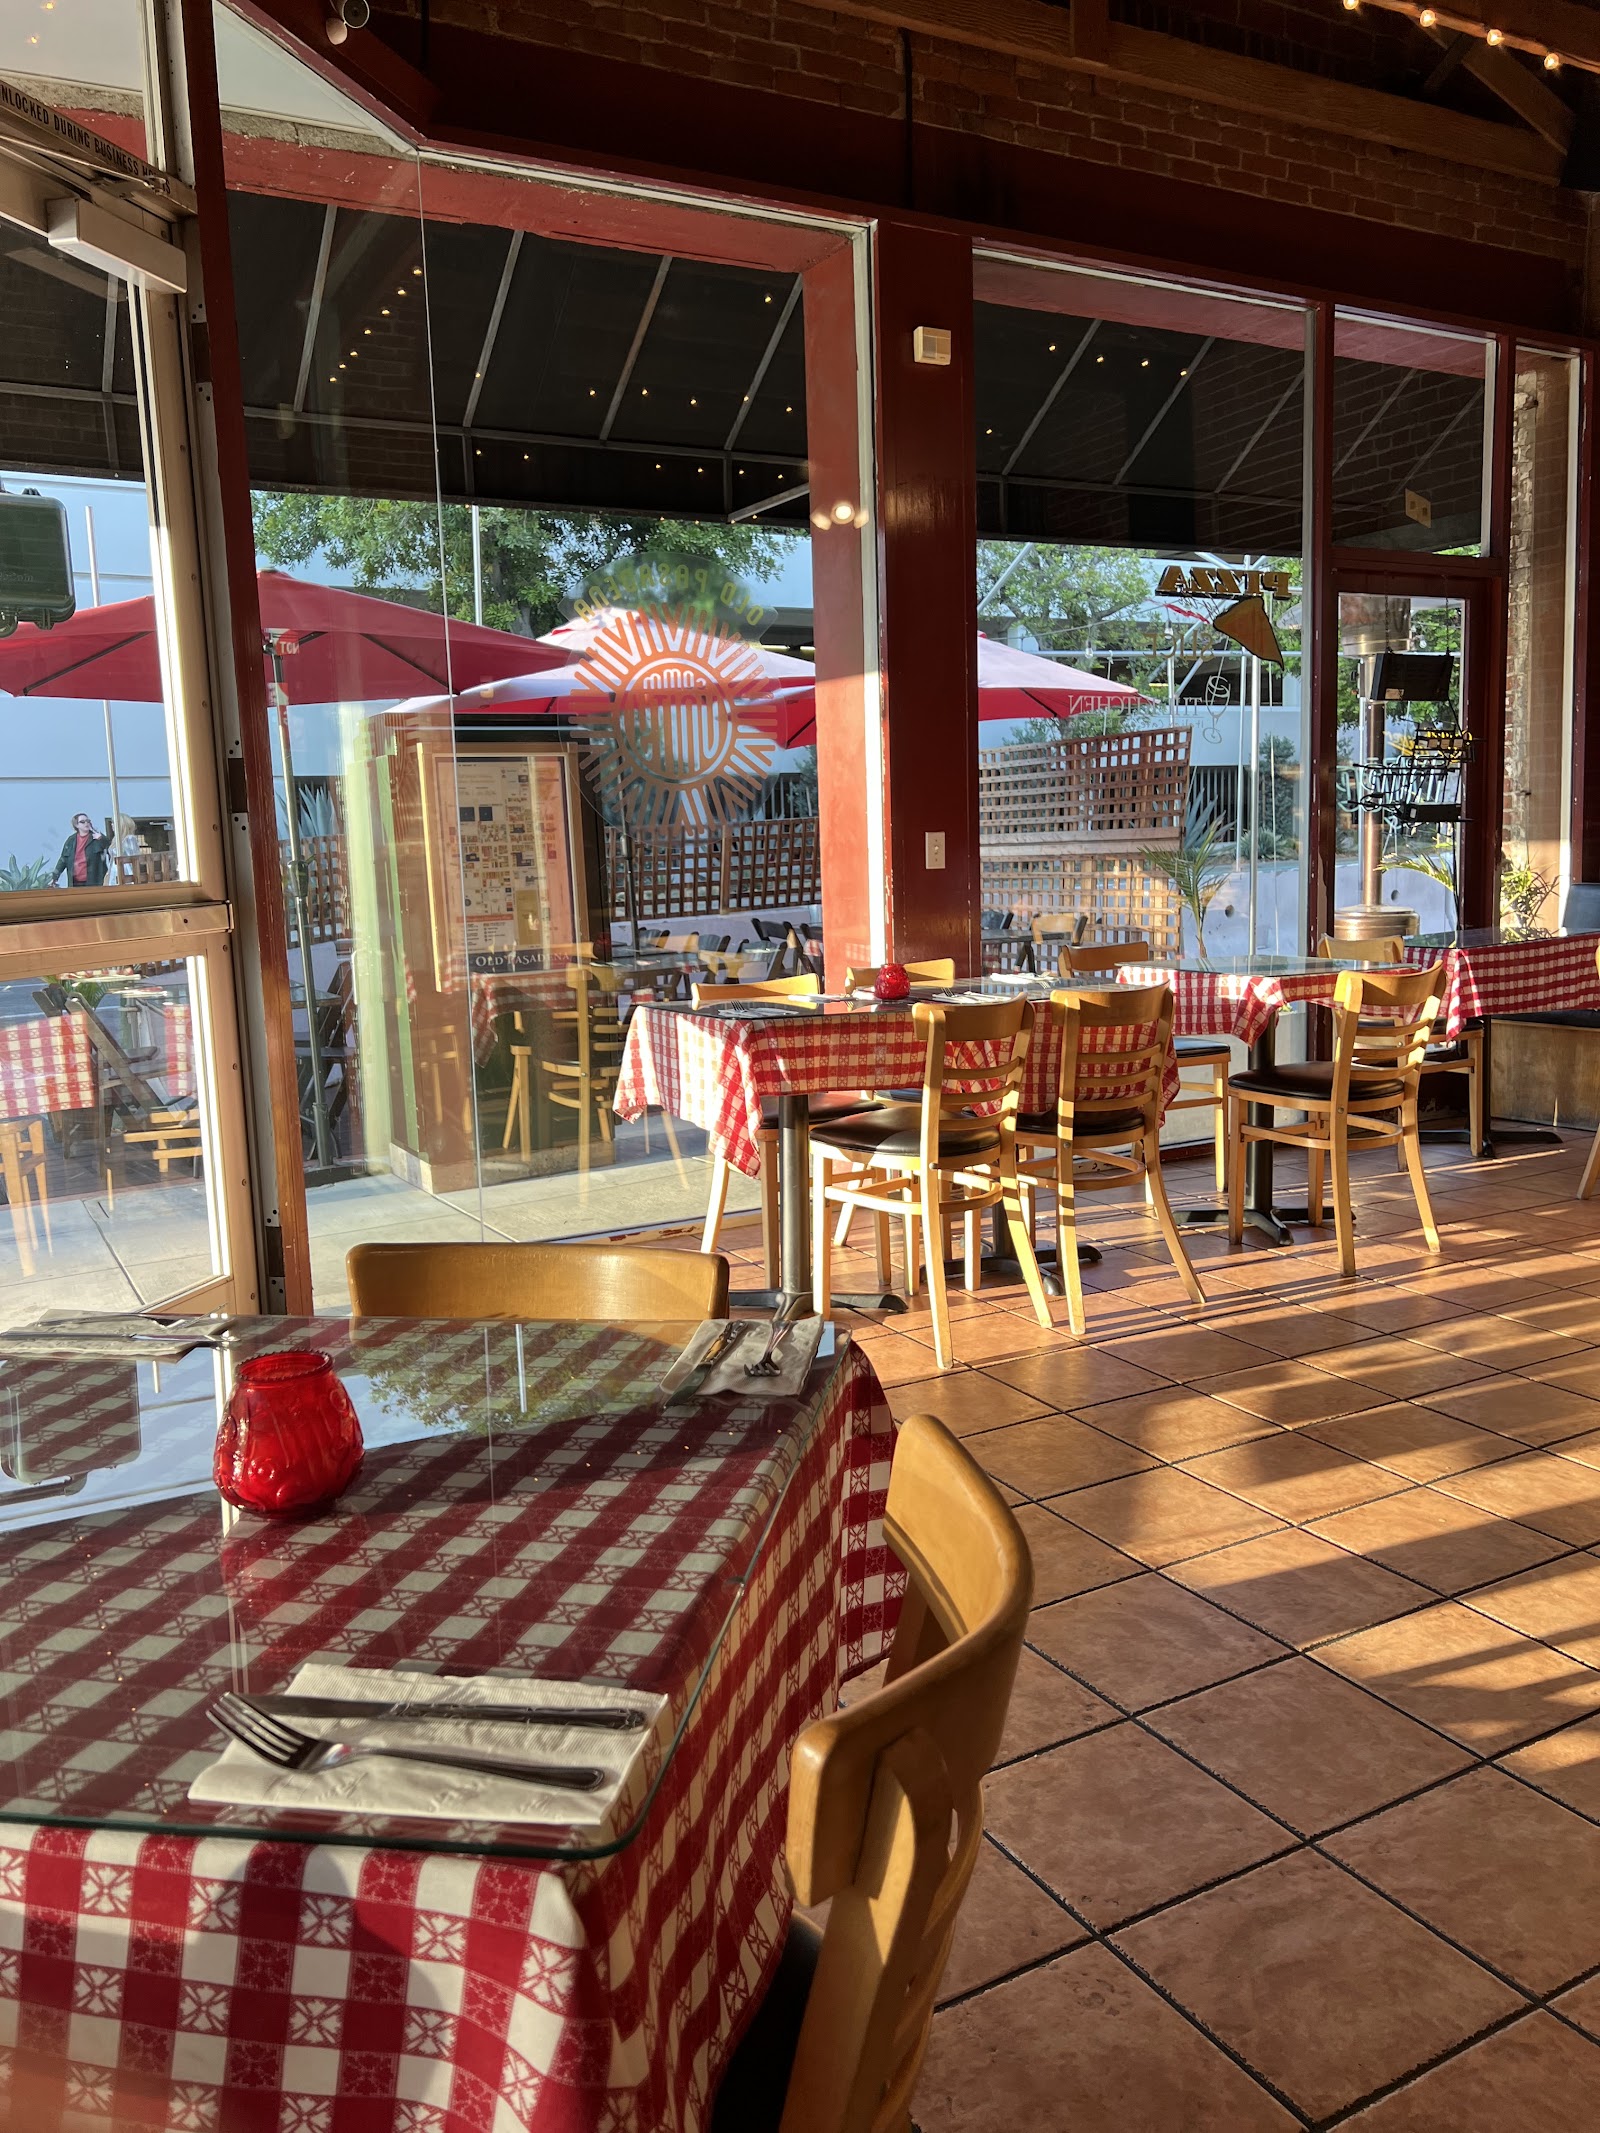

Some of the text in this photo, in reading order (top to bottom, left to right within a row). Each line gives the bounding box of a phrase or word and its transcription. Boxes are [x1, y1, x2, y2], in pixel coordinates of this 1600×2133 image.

[53, 114, 91, 148] DURING
[94, 137, 139, 176] BUSINESS
[142, 166, 171, 195] HOS
[475, 955, 504, 967] OLD
